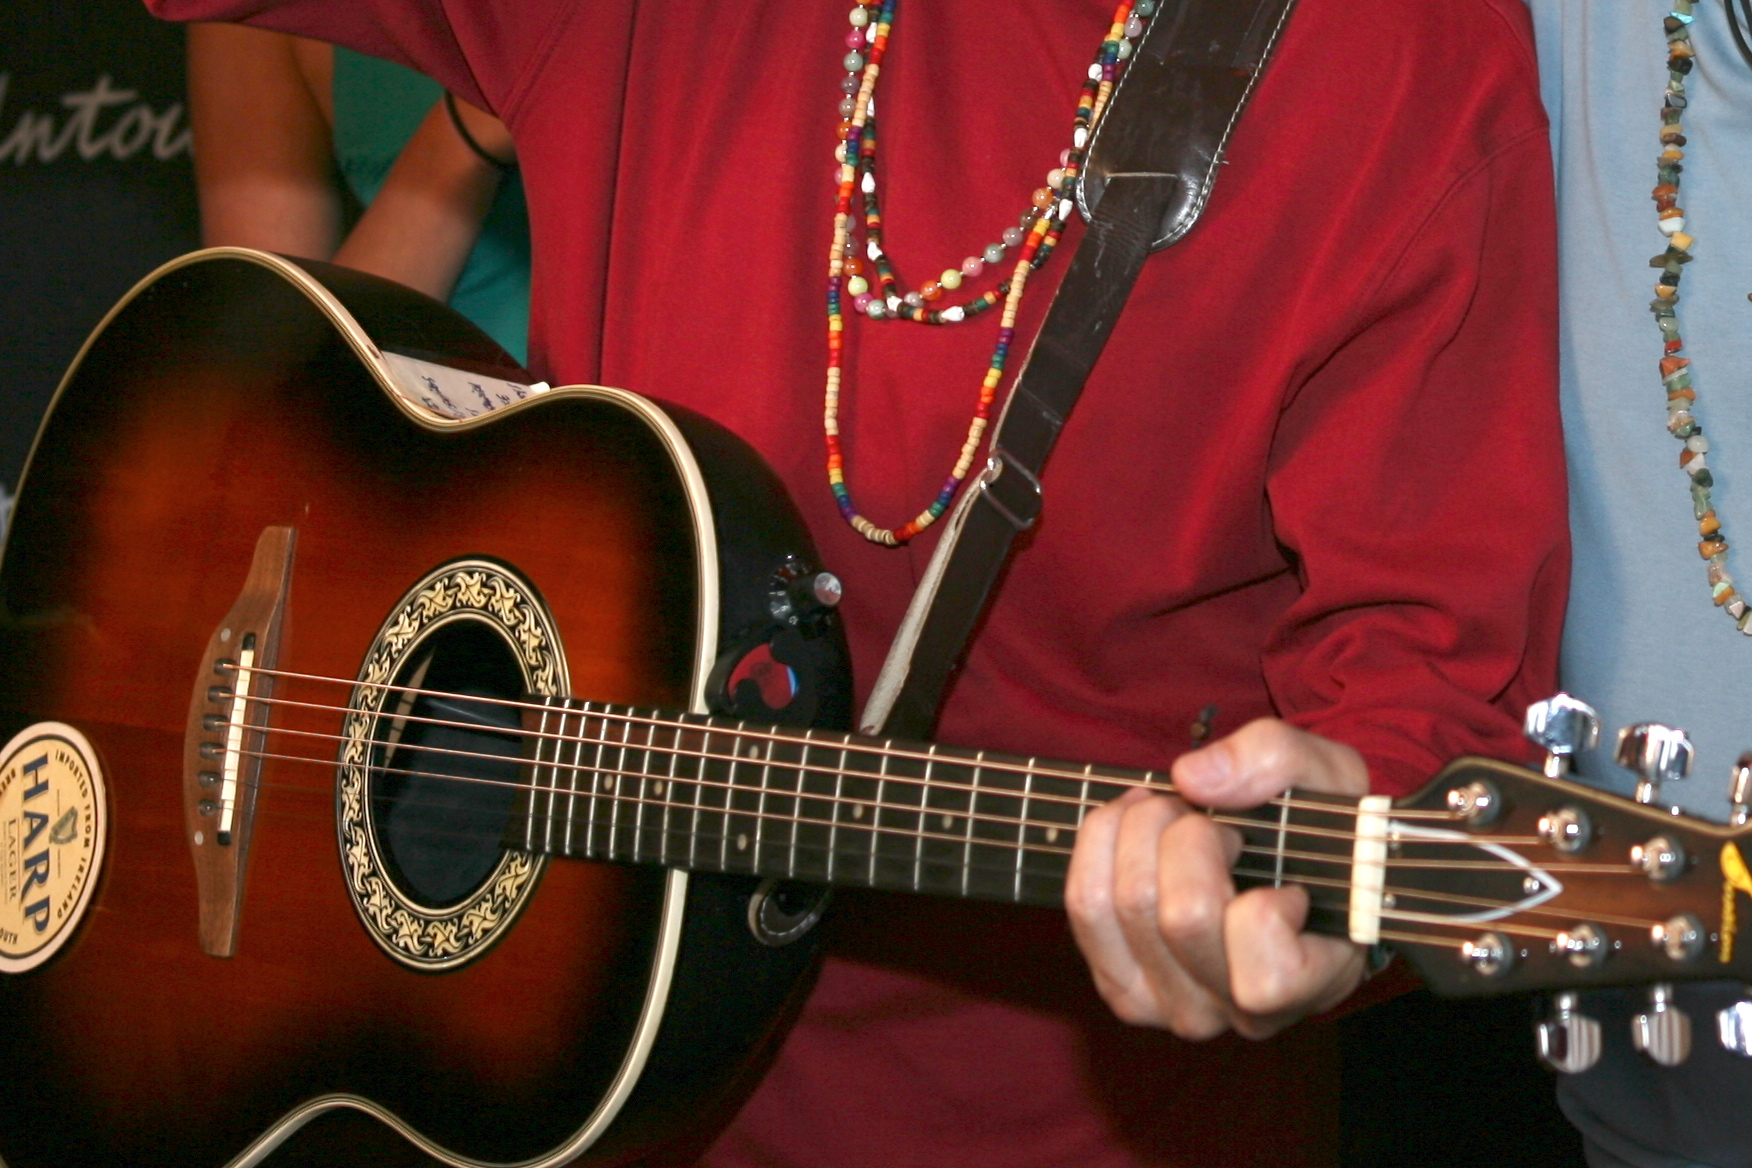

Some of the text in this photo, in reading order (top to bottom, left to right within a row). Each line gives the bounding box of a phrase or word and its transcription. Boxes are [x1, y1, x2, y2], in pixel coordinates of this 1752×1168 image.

[8, 818, 18, 903] LAGER
[20, 752, 51, 933] HARP
[55, 749, 92, 919] IMPORTED FROM IRELAND
